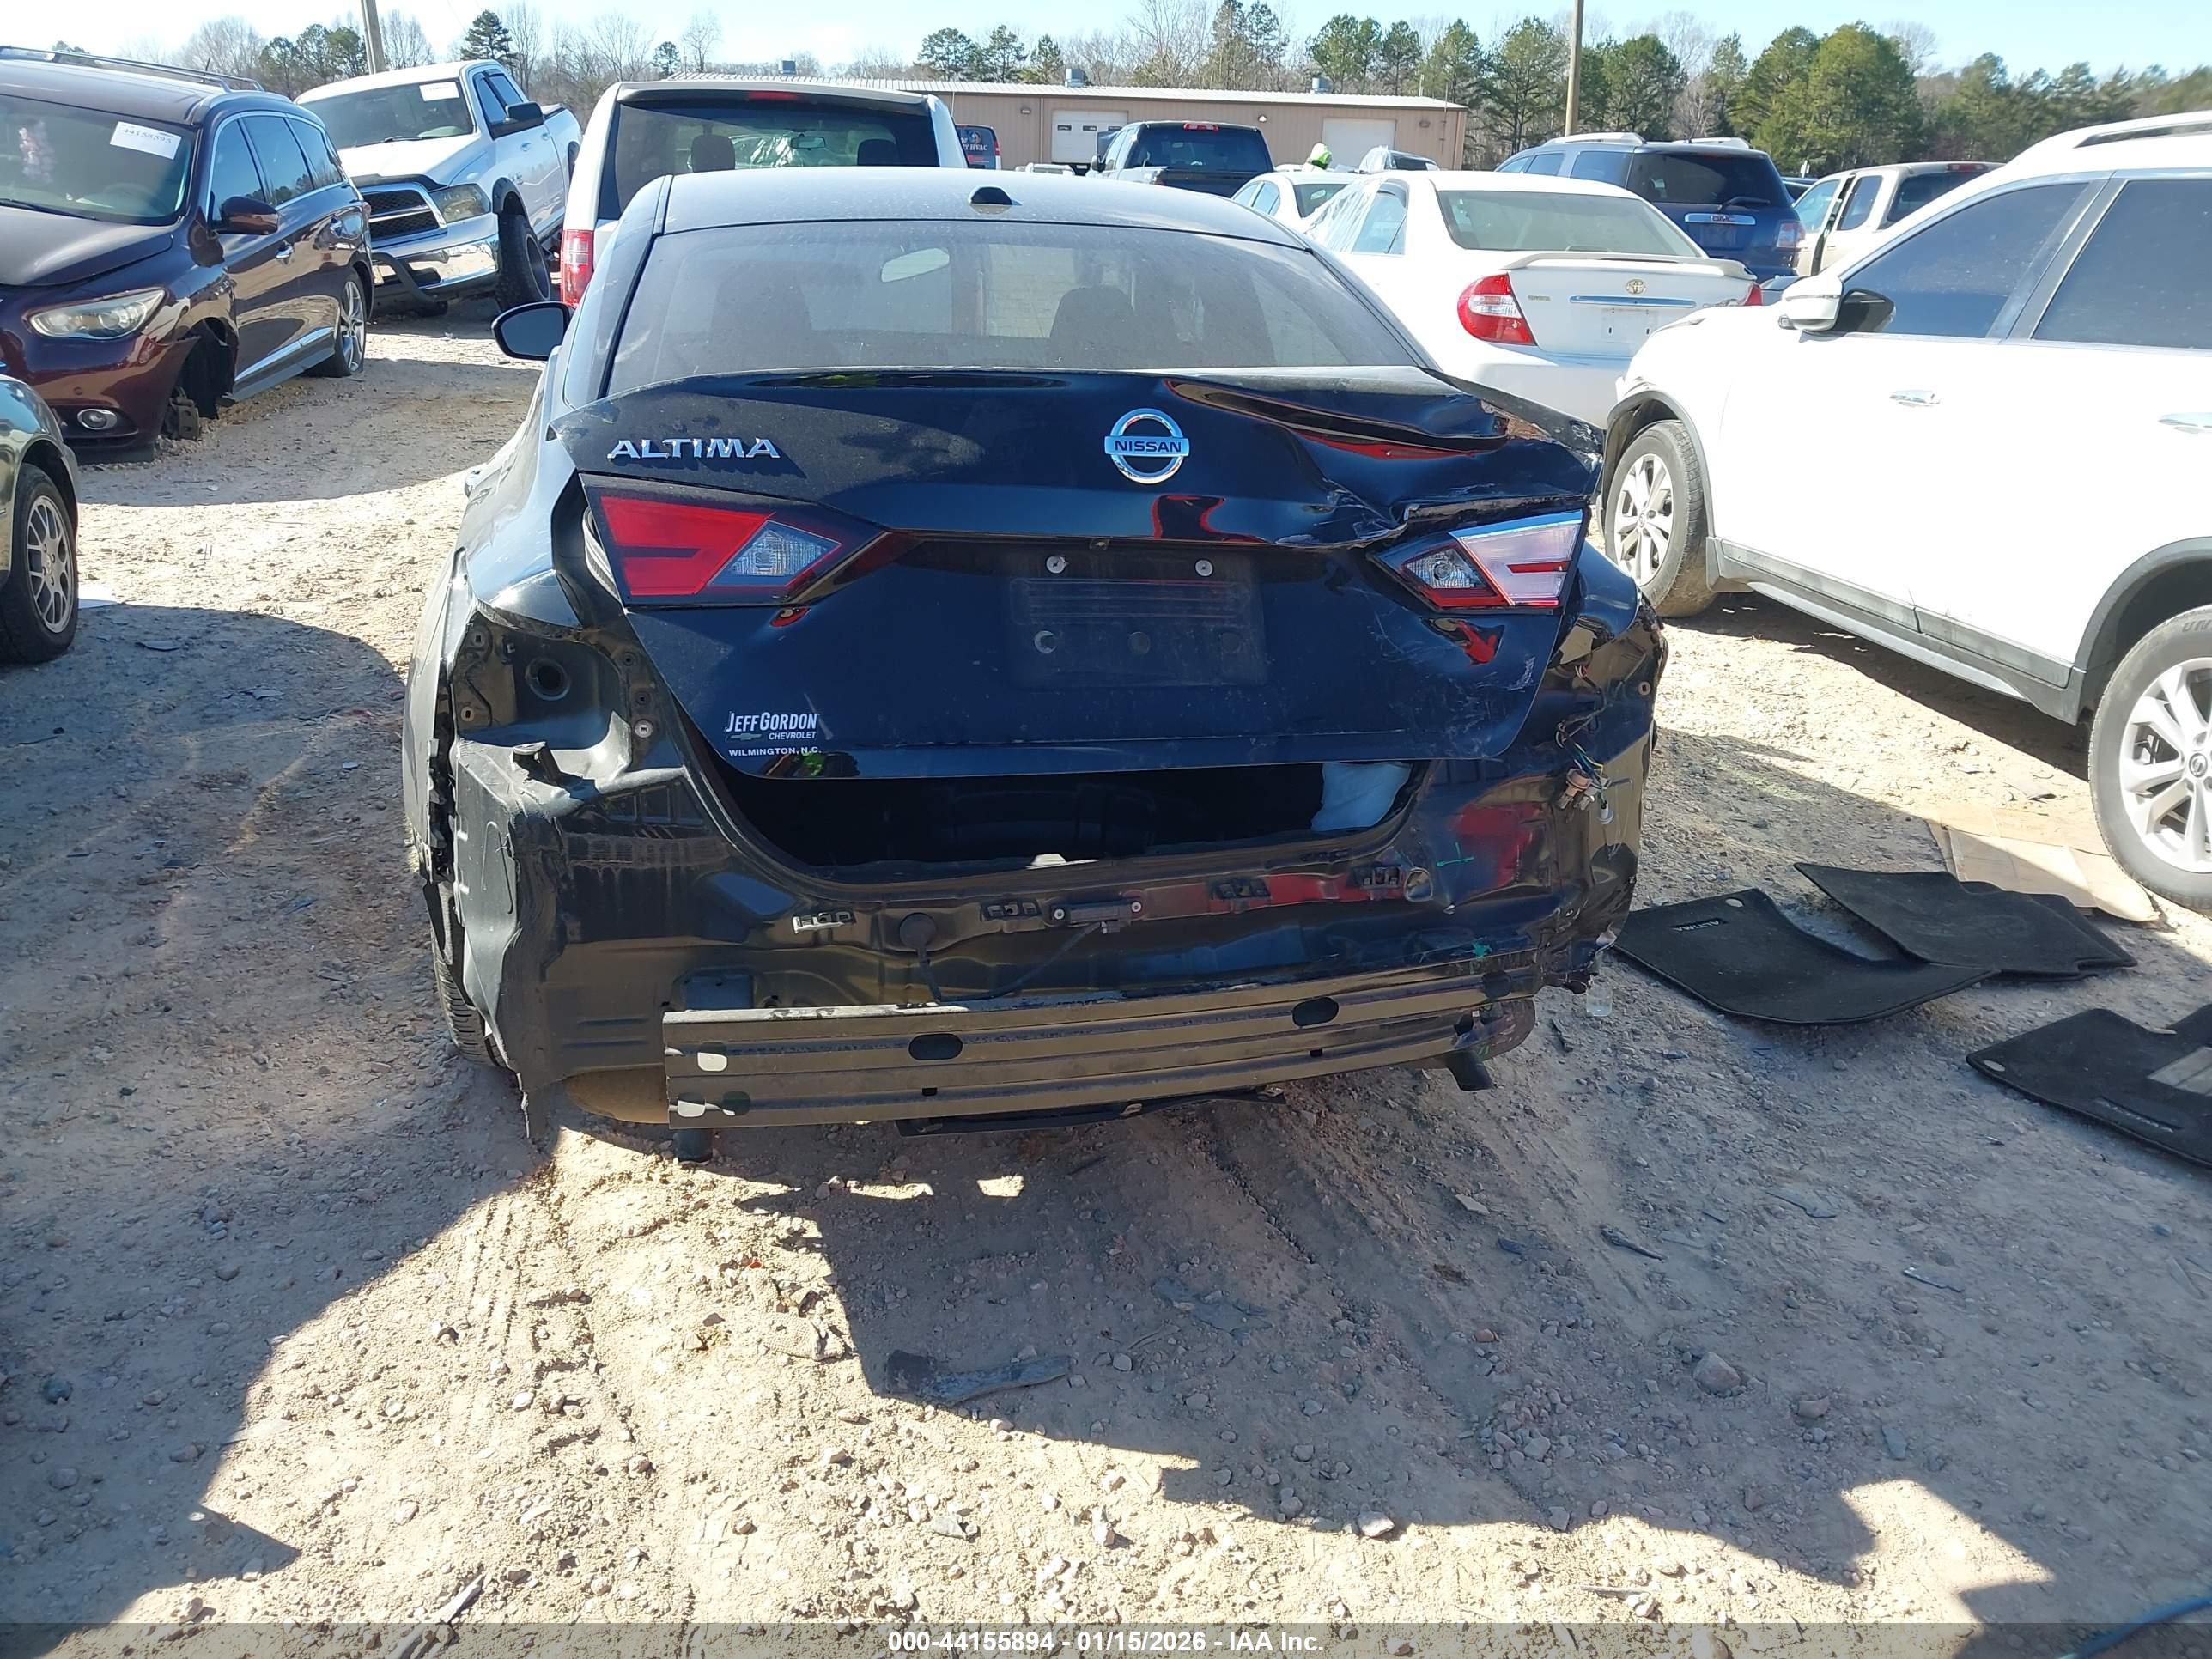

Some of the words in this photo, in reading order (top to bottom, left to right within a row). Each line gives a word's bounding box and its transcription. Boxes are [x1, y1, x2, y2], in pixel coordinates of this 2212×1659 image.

[607, 438, 781, 459] ALTIMA
[1115, 440, 1182, 453] NISSAN
[769, 732, 817, 740] CHEVROLET
[729, 747, 799, 757] WILMINGTON,
[801, 746, 822, 756] N.C.
